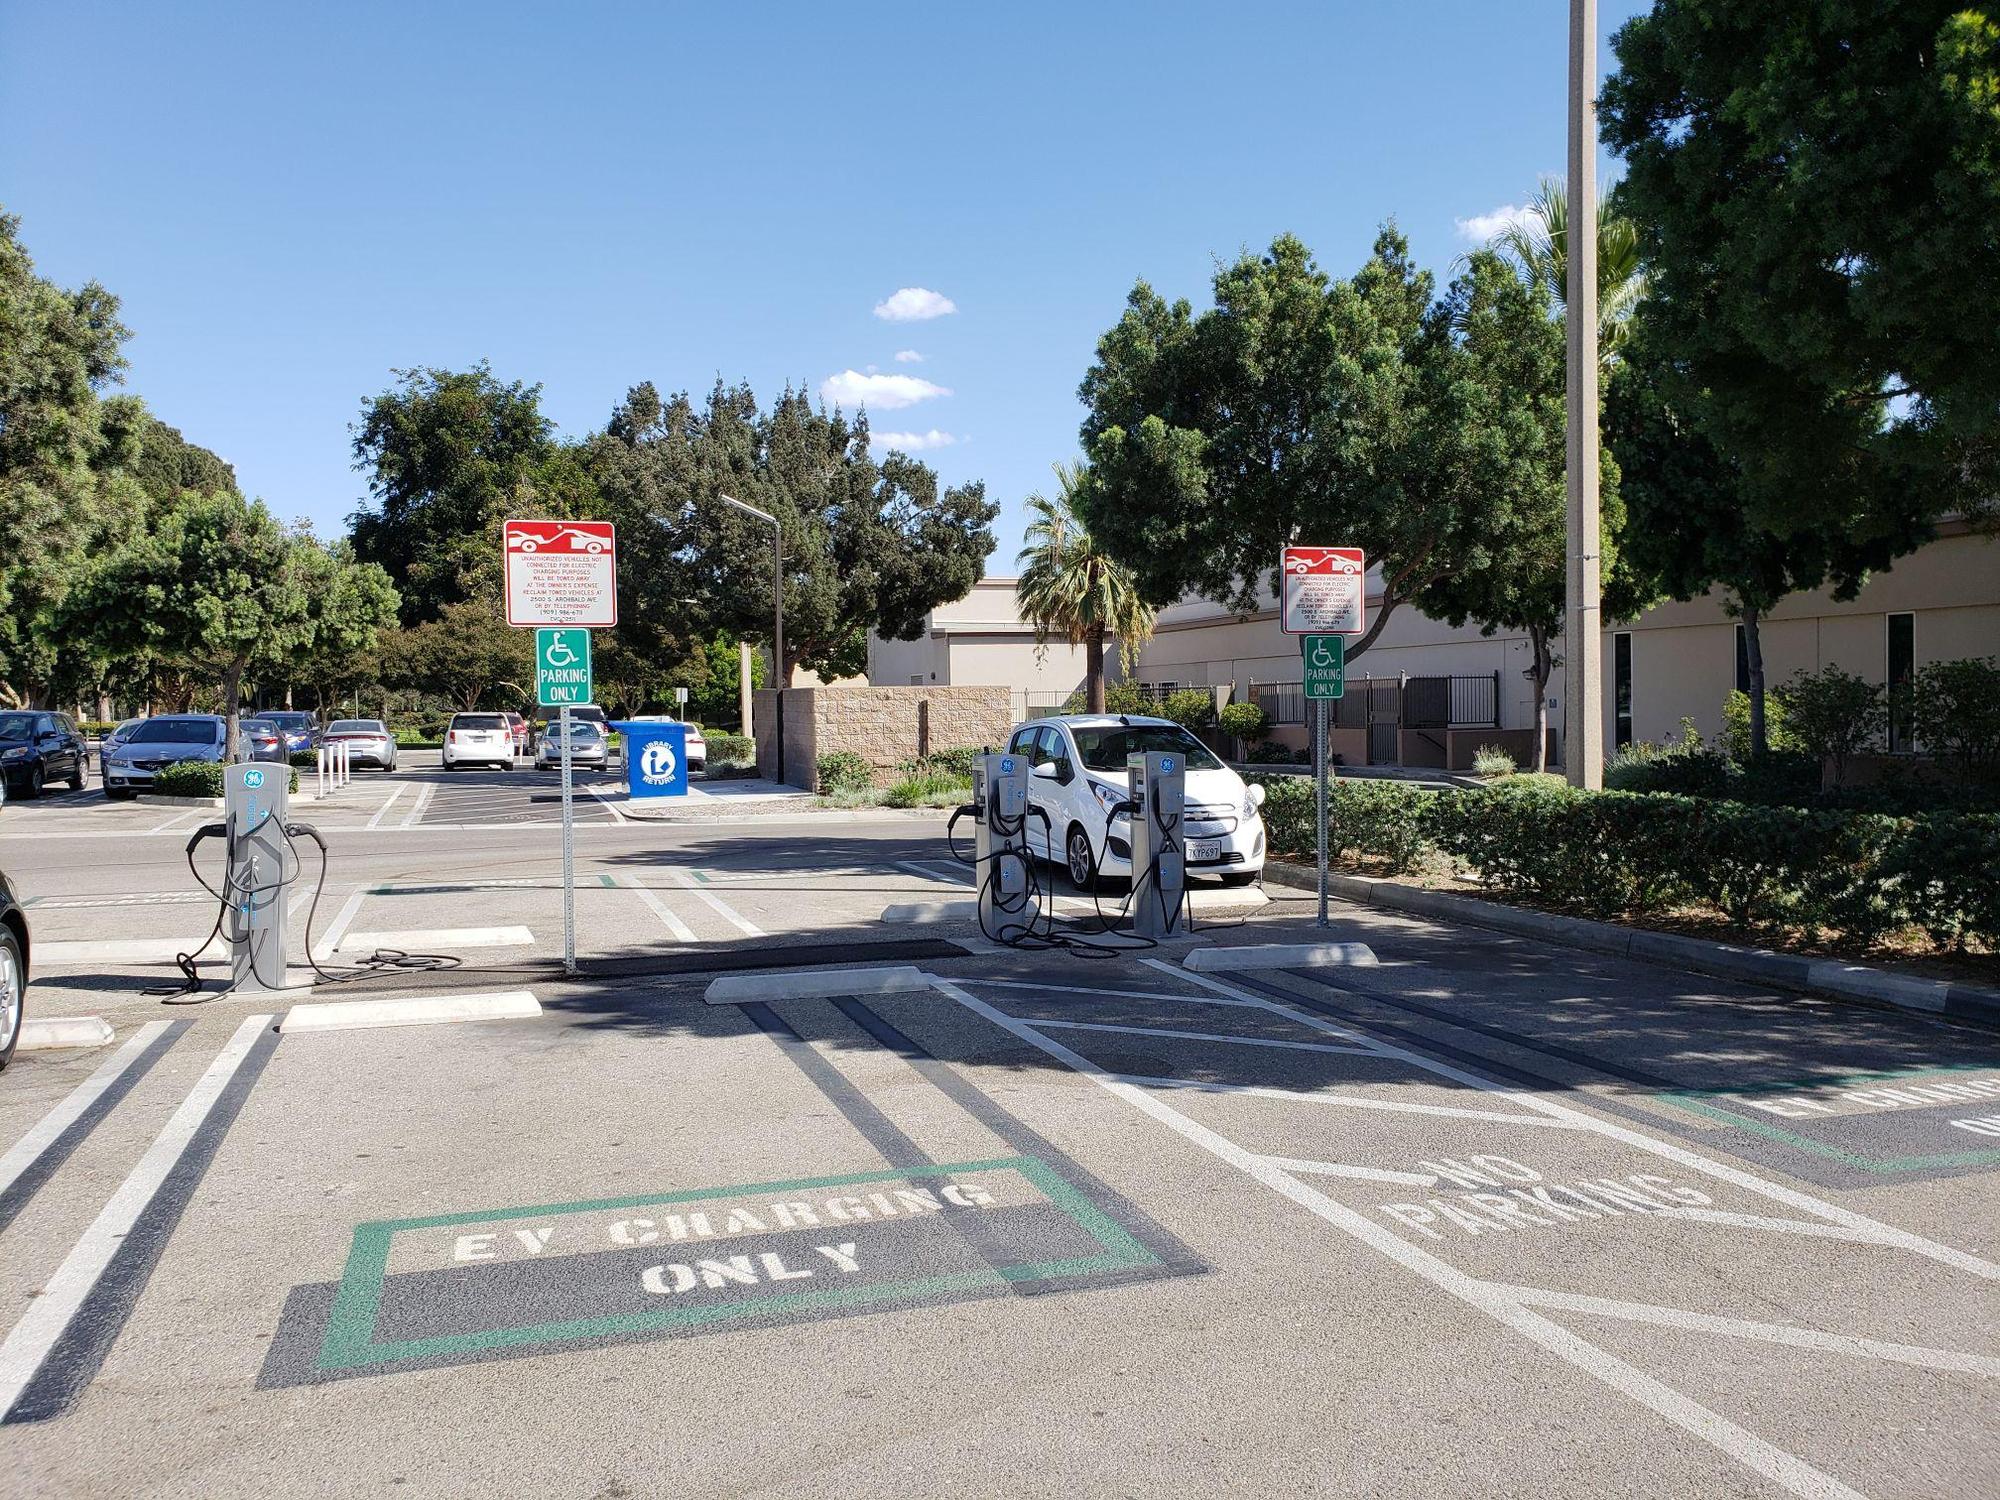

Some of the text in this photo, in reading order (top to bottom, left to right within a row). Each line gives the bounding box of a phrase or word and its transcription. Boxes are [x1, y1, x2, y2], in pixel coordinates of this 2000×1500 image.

[541, 669, 586, 683] PARKING
[1308, 669, 1341, 680] PARKING
[550, 686, 578, 701] ONLY
[1314, 684, 1334, 695] ONLY
[642, 741, 674, 752] LIBRARY
[642, 774, 676, 786] RETURN
[1418, 1154, 1542, 1188] NO
[1381, 1174, 1712, 1239] PARKING
[453, 1184, 995, 1262] EV CHARGING
[640, 1242, 861, 1296] ONLY
